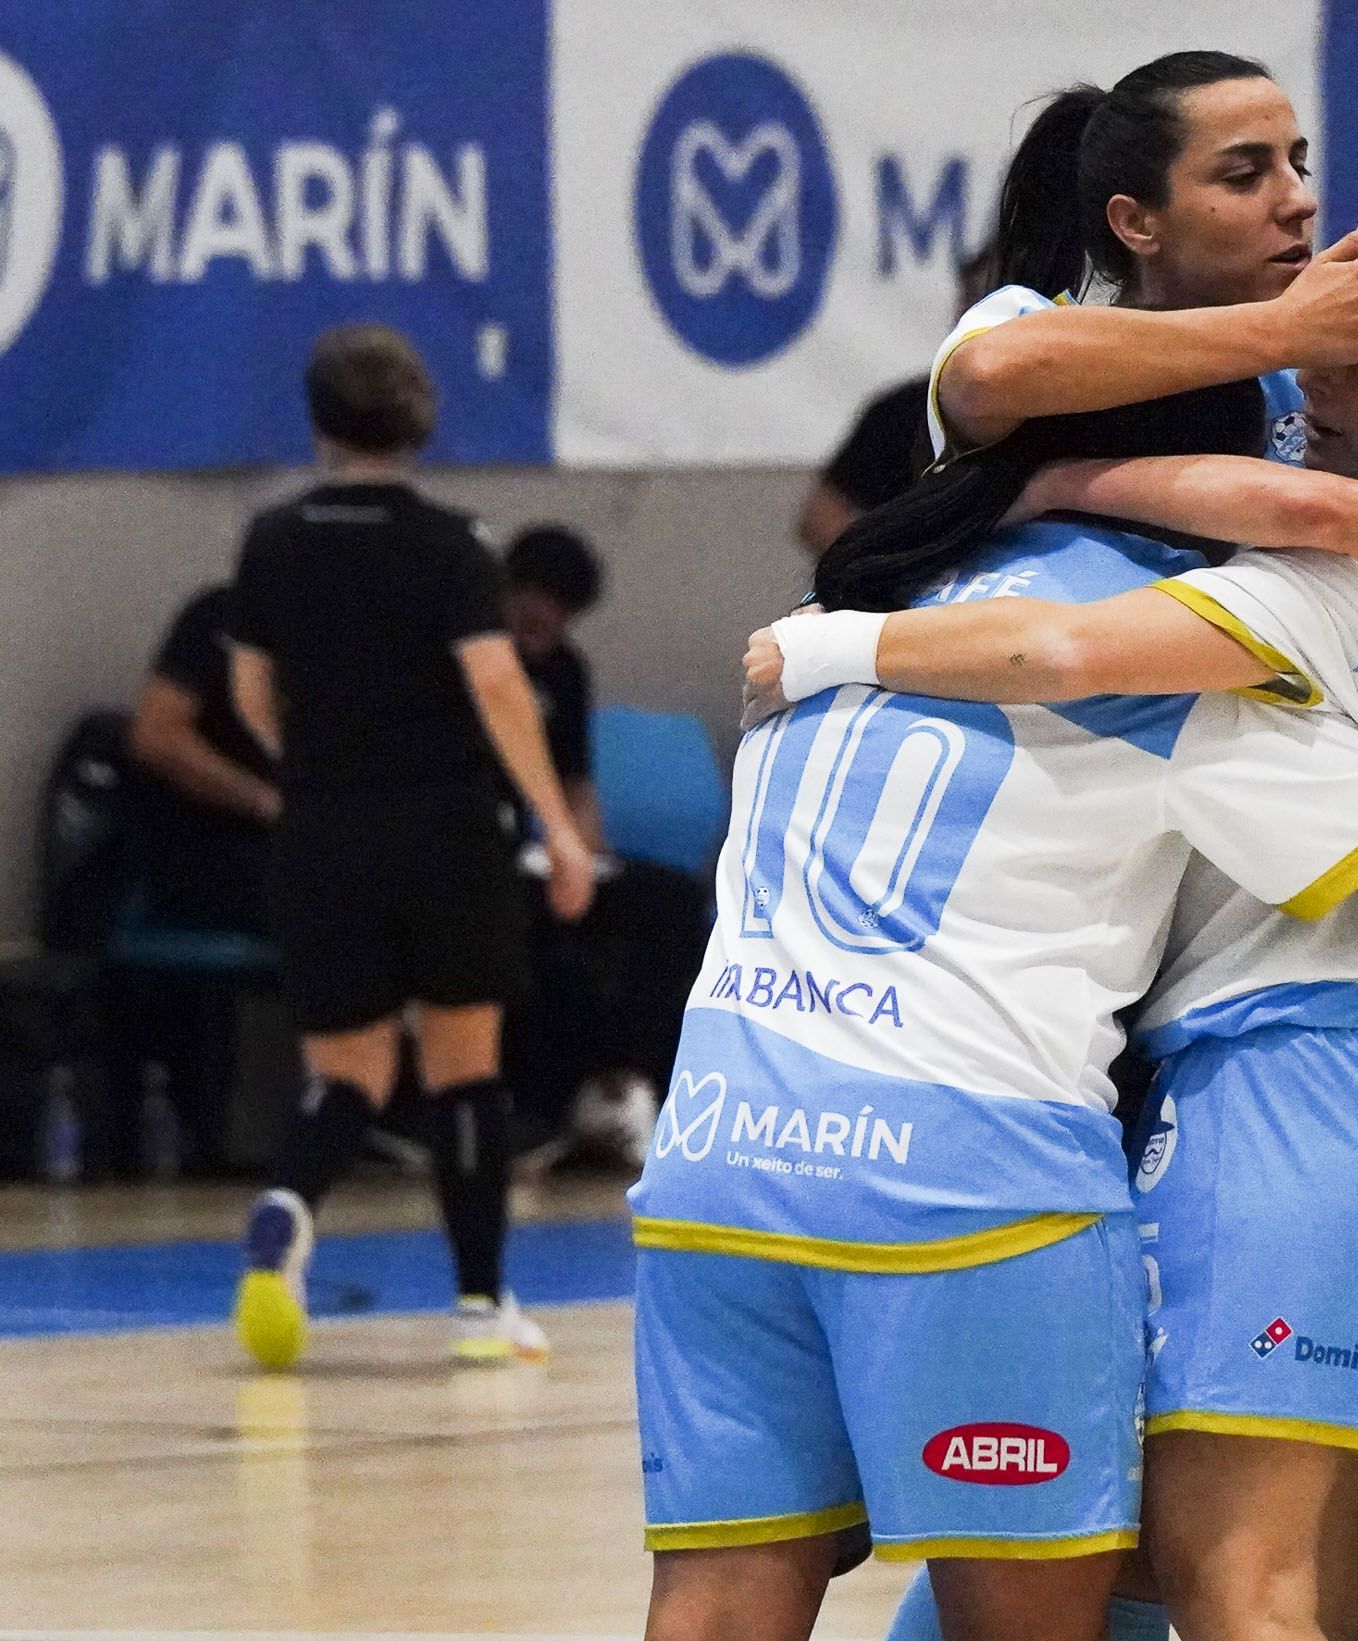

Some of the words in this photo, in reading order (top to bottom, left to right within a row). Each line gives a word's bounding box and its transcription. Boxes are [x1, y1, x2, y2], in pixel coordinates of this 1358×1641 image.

[82, 107, 489, 284] MARÍN
[740, 686, 1016, 955] 10
[726, 1150, 749, 1167] Un
[752, 1156, 793, 1175] xeito
[795, 1160, 813, 1176] de
[815, 1165, 844, 1181] ser.
[730, 1101, 913, 1166] MARÍN
[941, 1436, 1059, 1473] ABRIL
